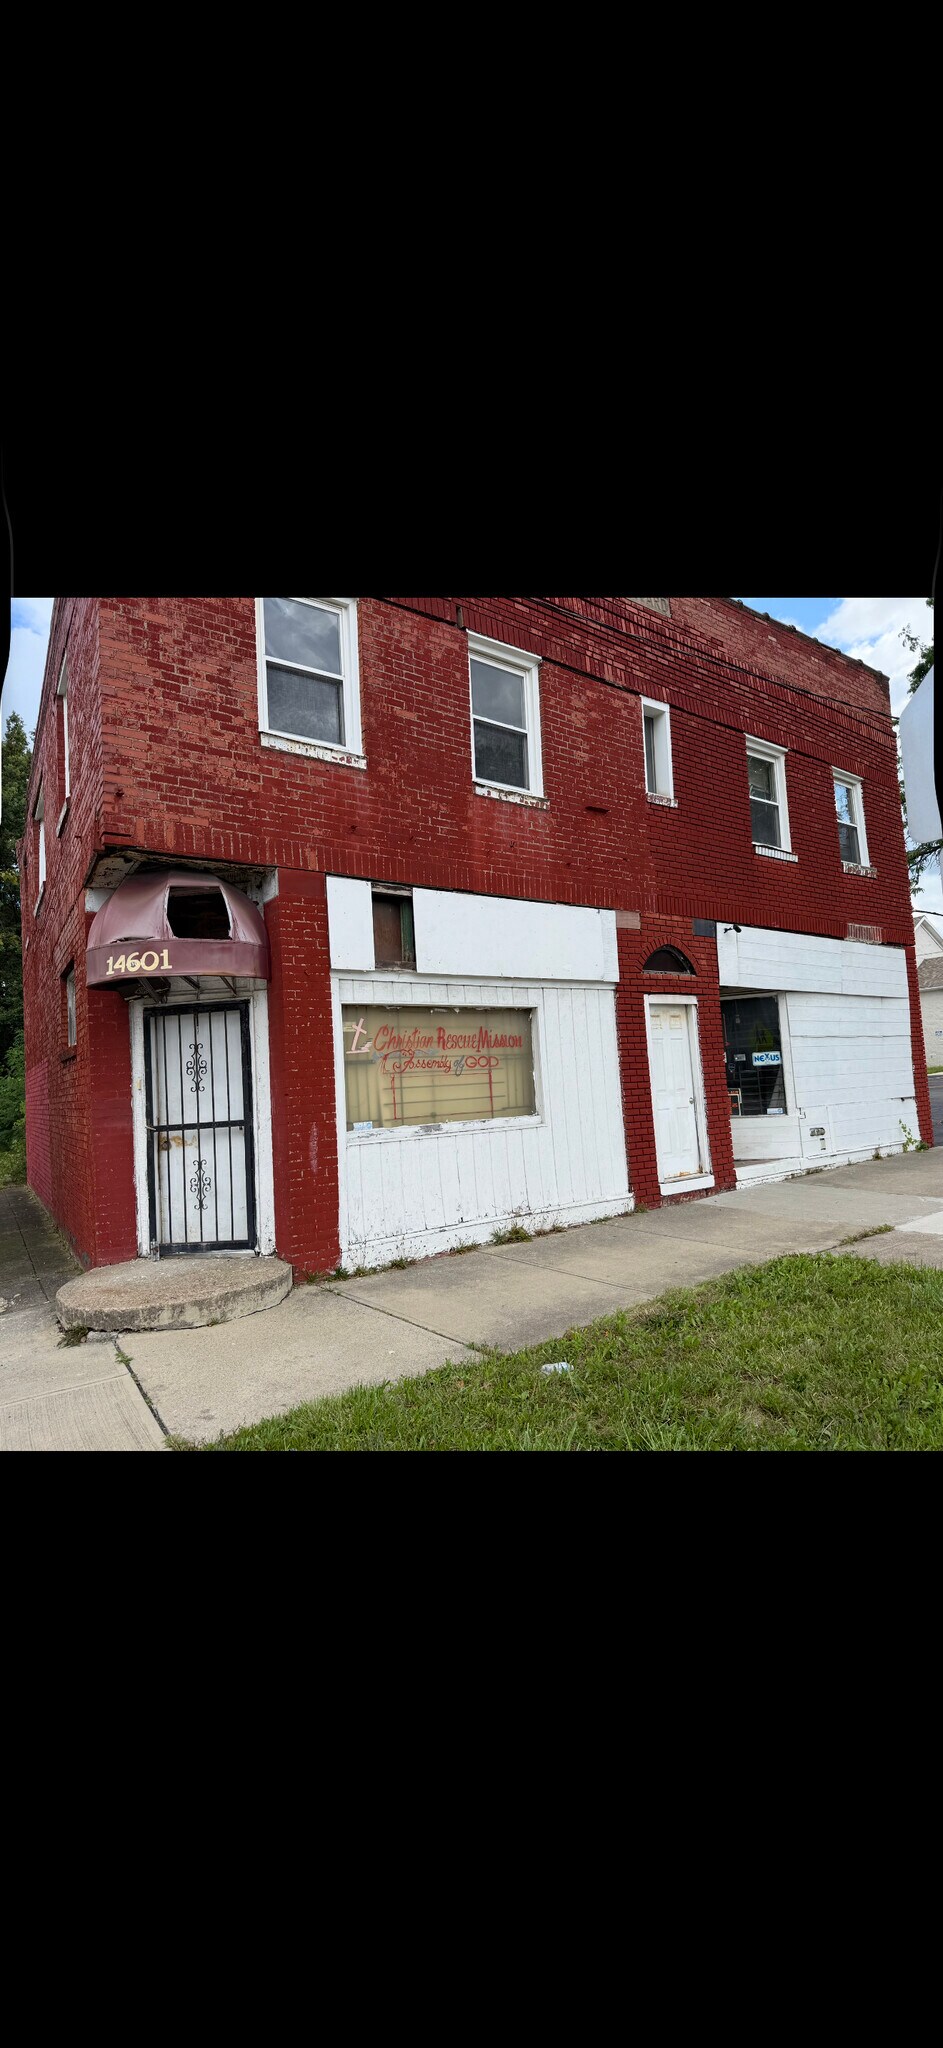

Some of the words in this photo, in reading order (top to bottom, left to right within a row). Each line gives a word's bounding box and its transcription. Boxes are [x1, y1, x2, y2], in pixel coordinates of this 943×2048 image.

[106, 949, 173, 975] 14601
[373, 1024, 434, 1051] Christian
[393, 1049, 452, 1073] Assembly
[453, 1055, 465, 1076] of
[465, 1055, 499, 1068] GOD
[754, 1053, 780, 1062] NEXUS
